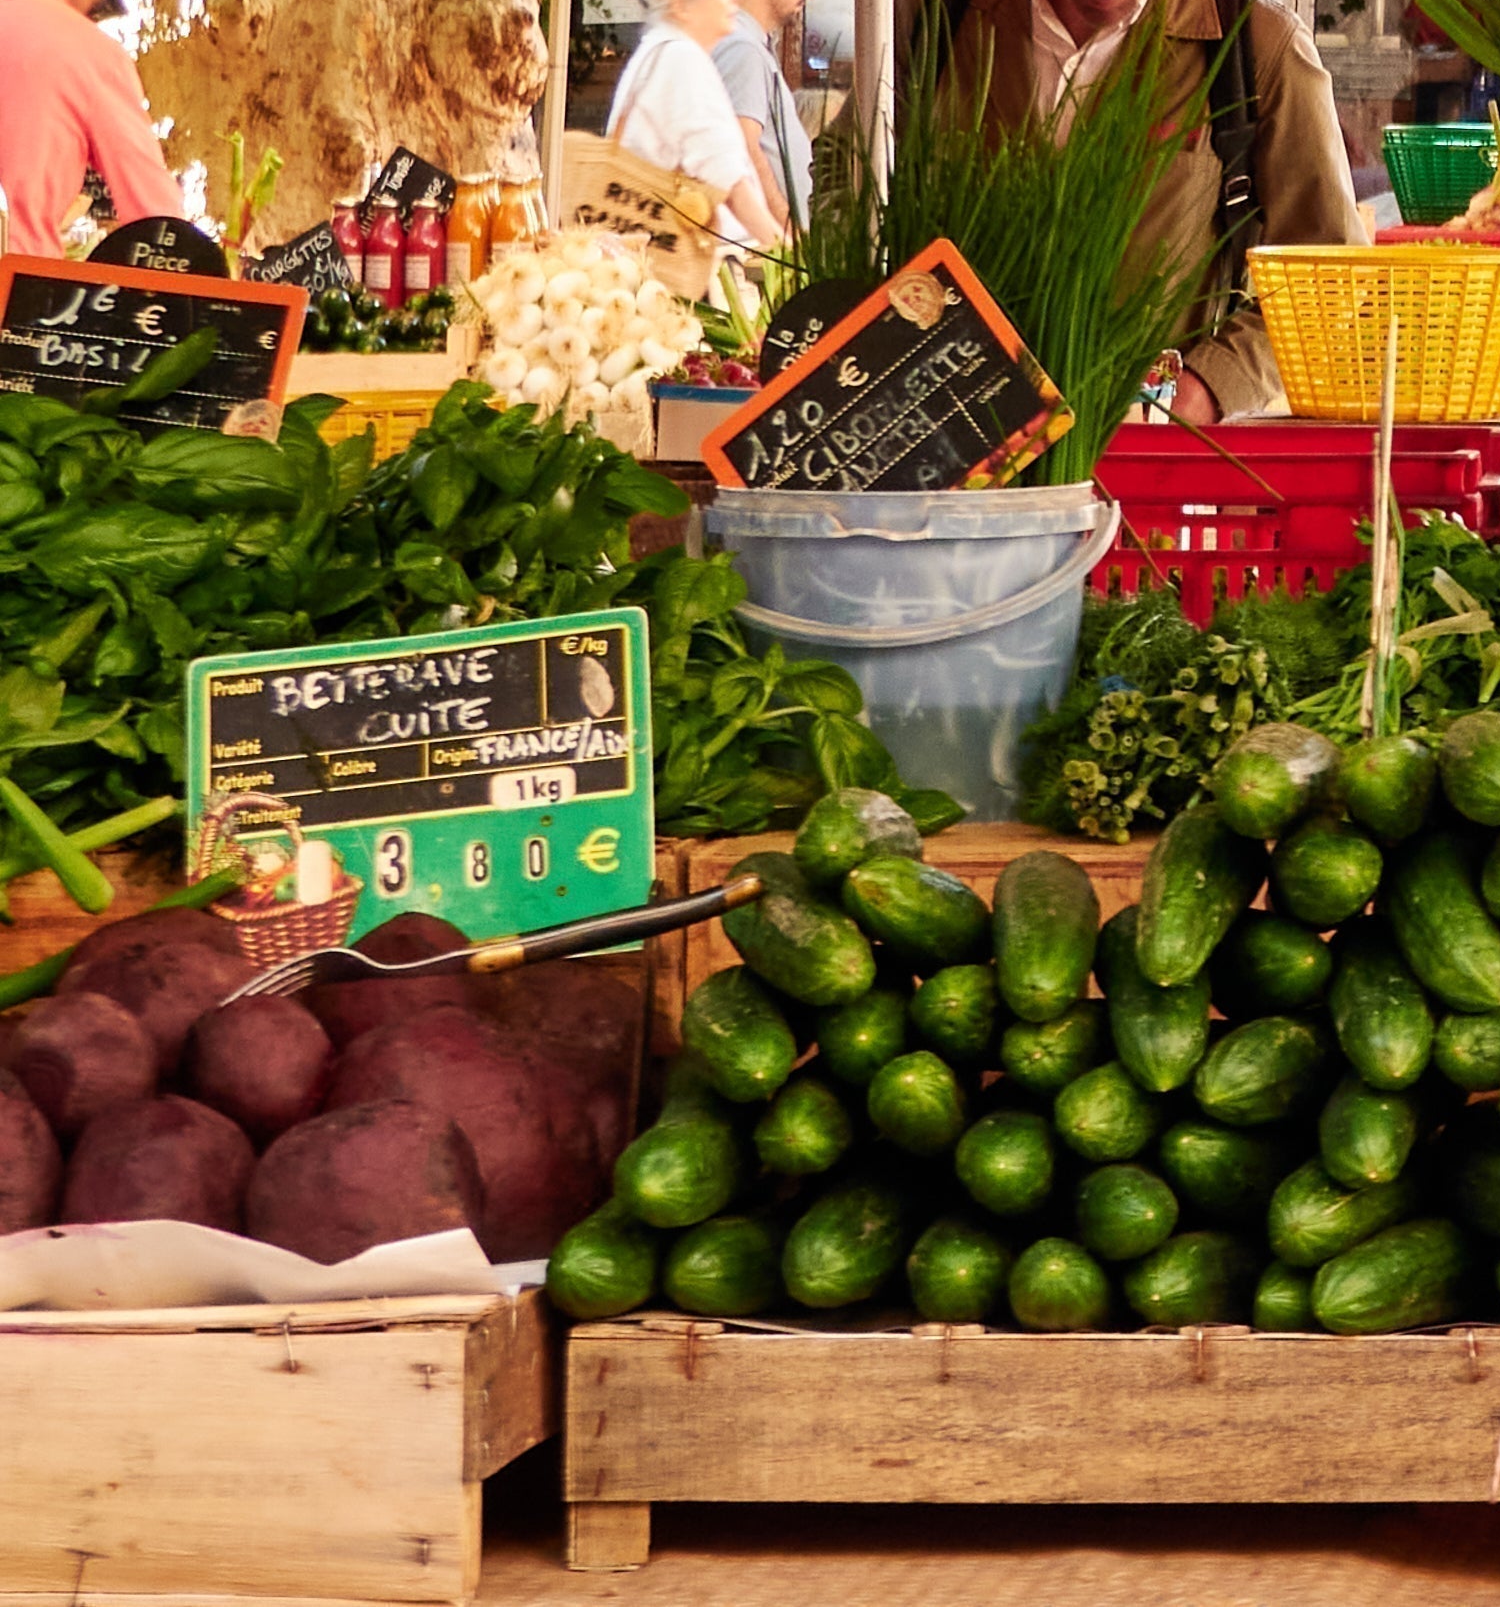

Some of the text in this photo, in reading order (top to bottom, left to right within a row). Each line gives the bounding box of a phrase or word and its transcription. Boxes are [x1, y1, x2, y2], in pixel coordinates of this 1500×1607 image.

[157, 221, 176, 246] la
[131, 241, 192, 273] Pièce
[767, 328, 796, 350] la
[213, 677, 264, 697] Produit
[559, 635, 609, 656] €/kg
[214, 738, 262, 759] Variété
[214, 771, 275, 792] Catégorie
[332, 759, 378, 777] Calibre
[238, 806, 303, 825] Traitement
